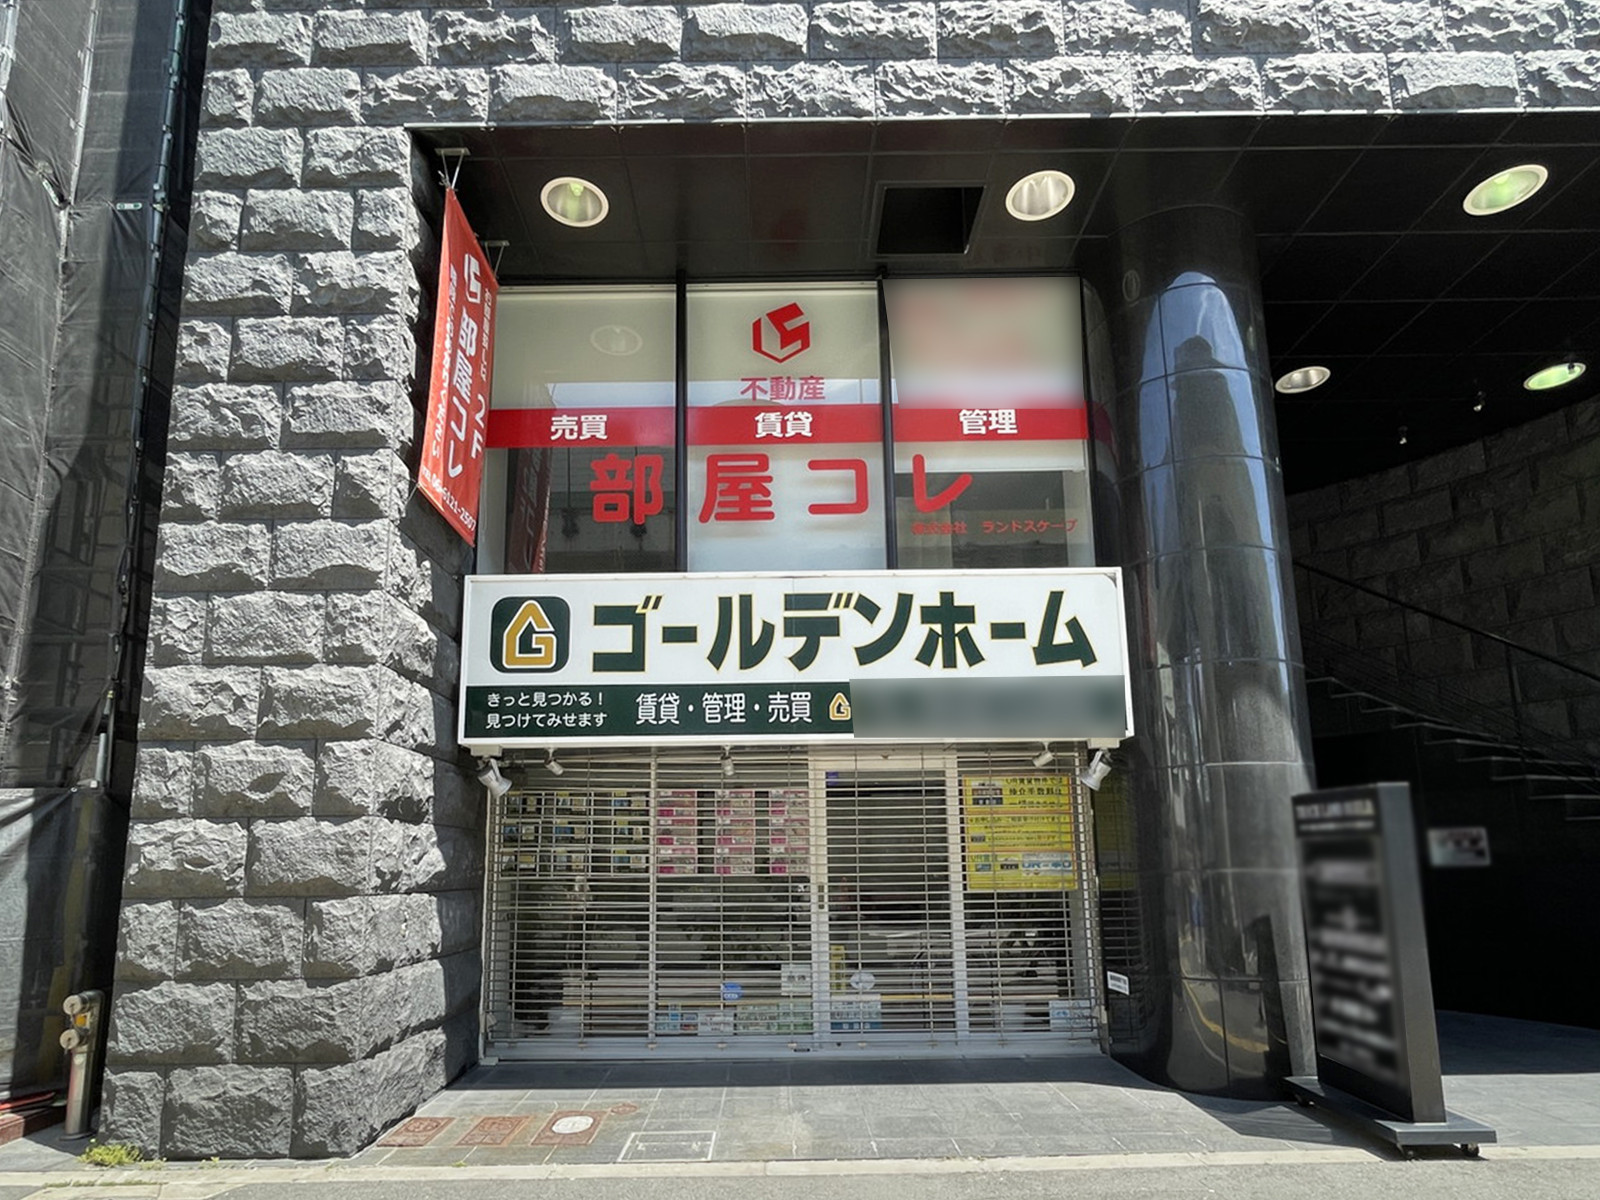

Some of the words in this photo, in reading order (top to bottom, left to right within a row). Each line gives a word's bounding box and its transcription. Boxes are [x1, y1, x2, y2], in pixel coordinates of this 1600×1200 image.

[448, 306, 478, 478] 部屋コレ
[740, 376, 826, 401] 不動産
[471, 394, 485, 459] 2F
[550, 414, 608, 441] 売買
[754, 411, 813, 438] 賃貸
[958, 408, 1018, 436] 管理
[590, 453, 972, 525] 部屋コレ
[592, 590, 1098, 672] ゴールデンホーム
[485, 711, 608, 729] 見つけてみせます
[635, 690, 813, 726] 賃貸・管理・売買
